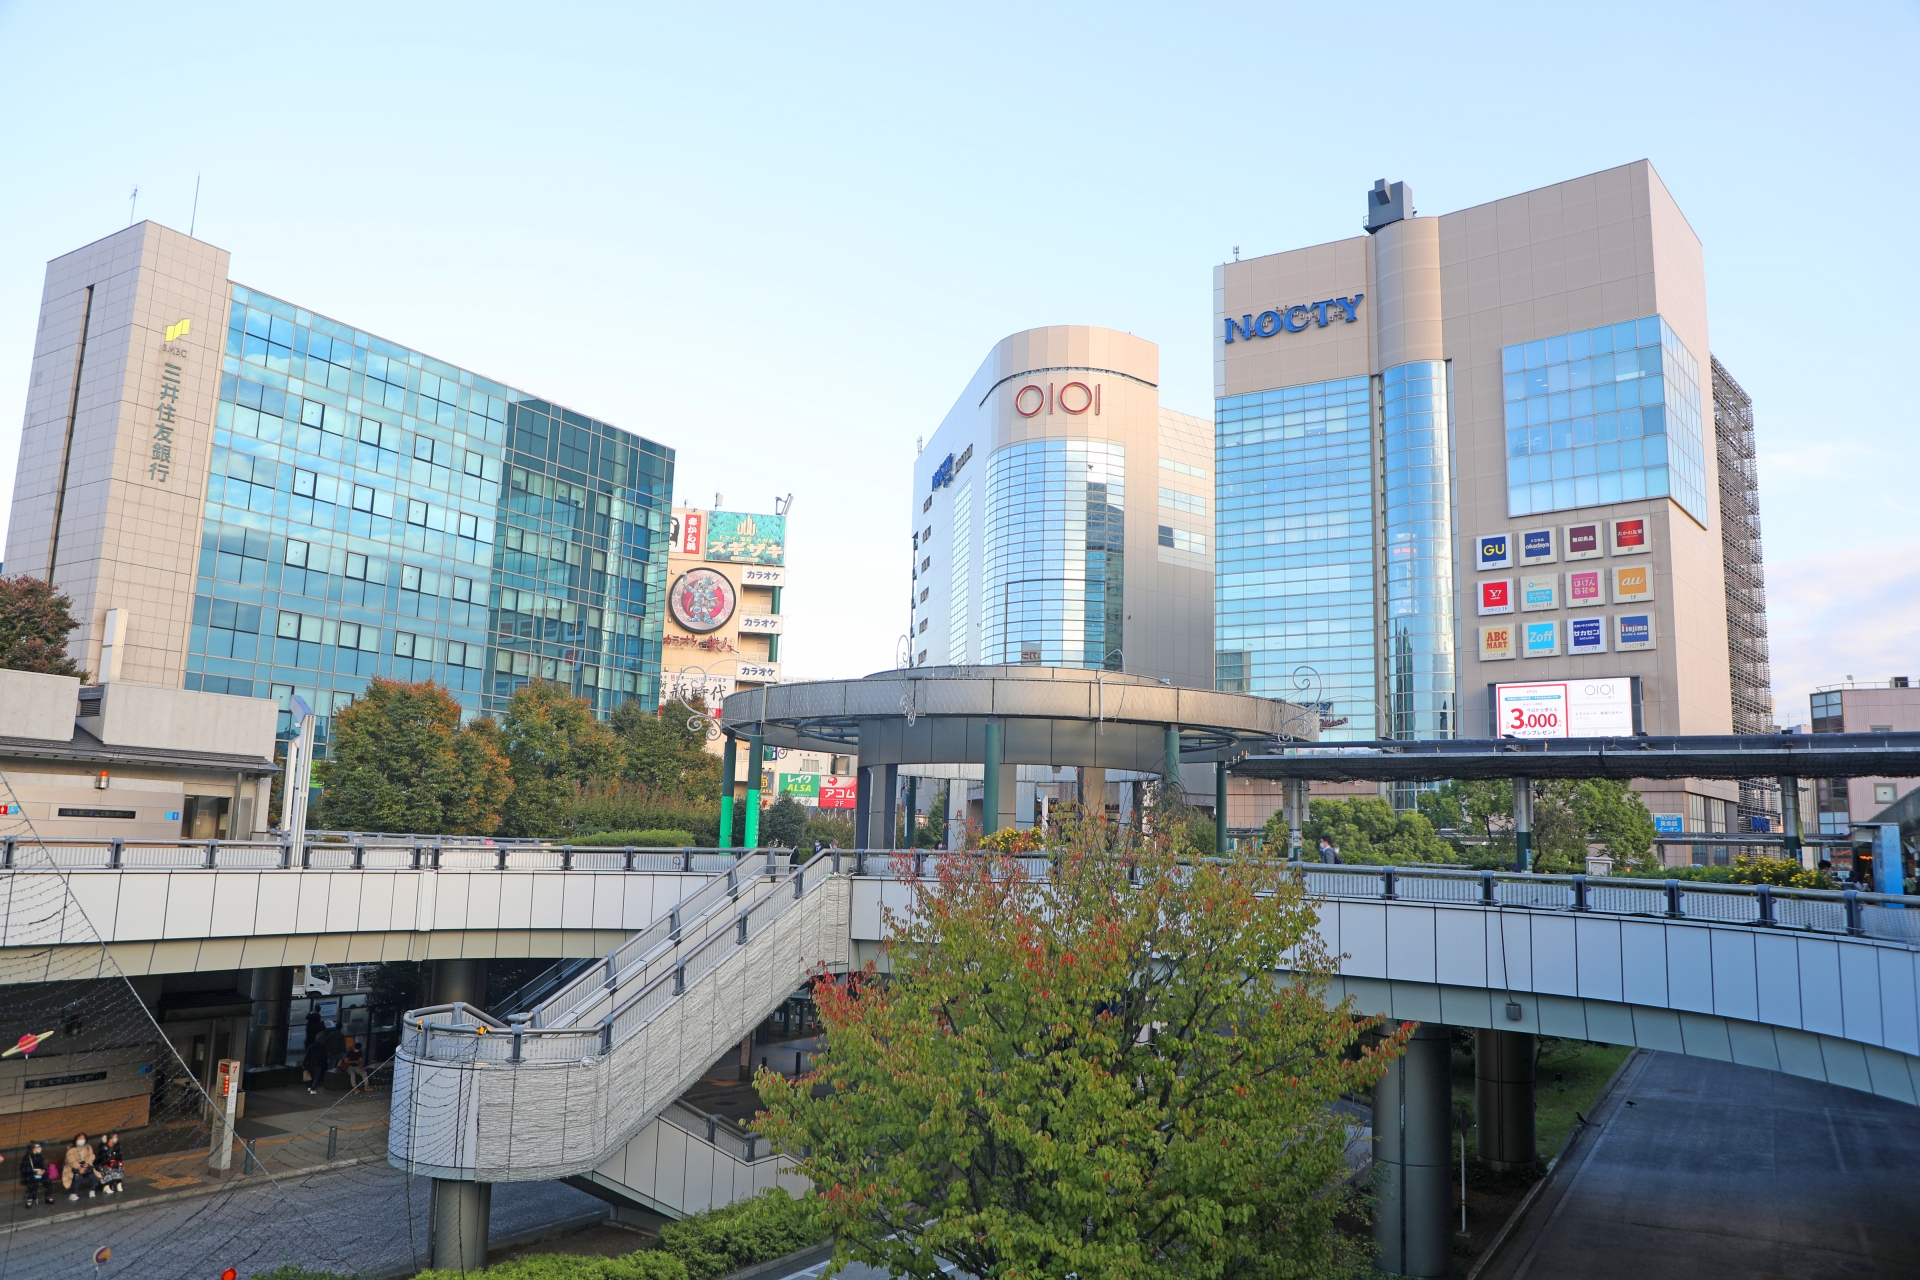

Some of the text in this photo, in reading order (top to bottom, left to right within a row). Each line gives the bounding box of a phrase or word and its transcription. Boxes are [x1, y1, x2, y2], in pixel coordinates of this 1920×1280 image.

[1225, 294, 1364, 344] NOCTY
[162, 343, 187, 358] SMBC
[149, 362, 182, 483] 三井住友銀行
[686, 517, 698, 551] 赤から鍋
[708, 541, 784, 558] スギザキ
[1483, 543, 1505, 556] GU
[747, 571, 780, 581] カラオケ
[1622, 577, 1643, 586] au
[1488, 589, 1502, 597] Y!
[1574, 587, 1589, 595] 百花
[744, 618, 778, 628] カラオケ
[1621, 623, 1647, 633] nojima
[1486, 631, 1507, 642] ABC
[1529, 631, 1553, 643] Zoff
[1573, 628, 1599, 636] サカゼン
[1486, 641, 1507, 649] MART
[741, 667, 776, 677] カラオケ
[1510, 708, 1557, 729] 3,000
[787, 774, 812, 783] レイク
[787, 784, 812, 792] ALSA
[825, 788, 856, 798] アコム
[232, 1065, 238, 1074] 7
